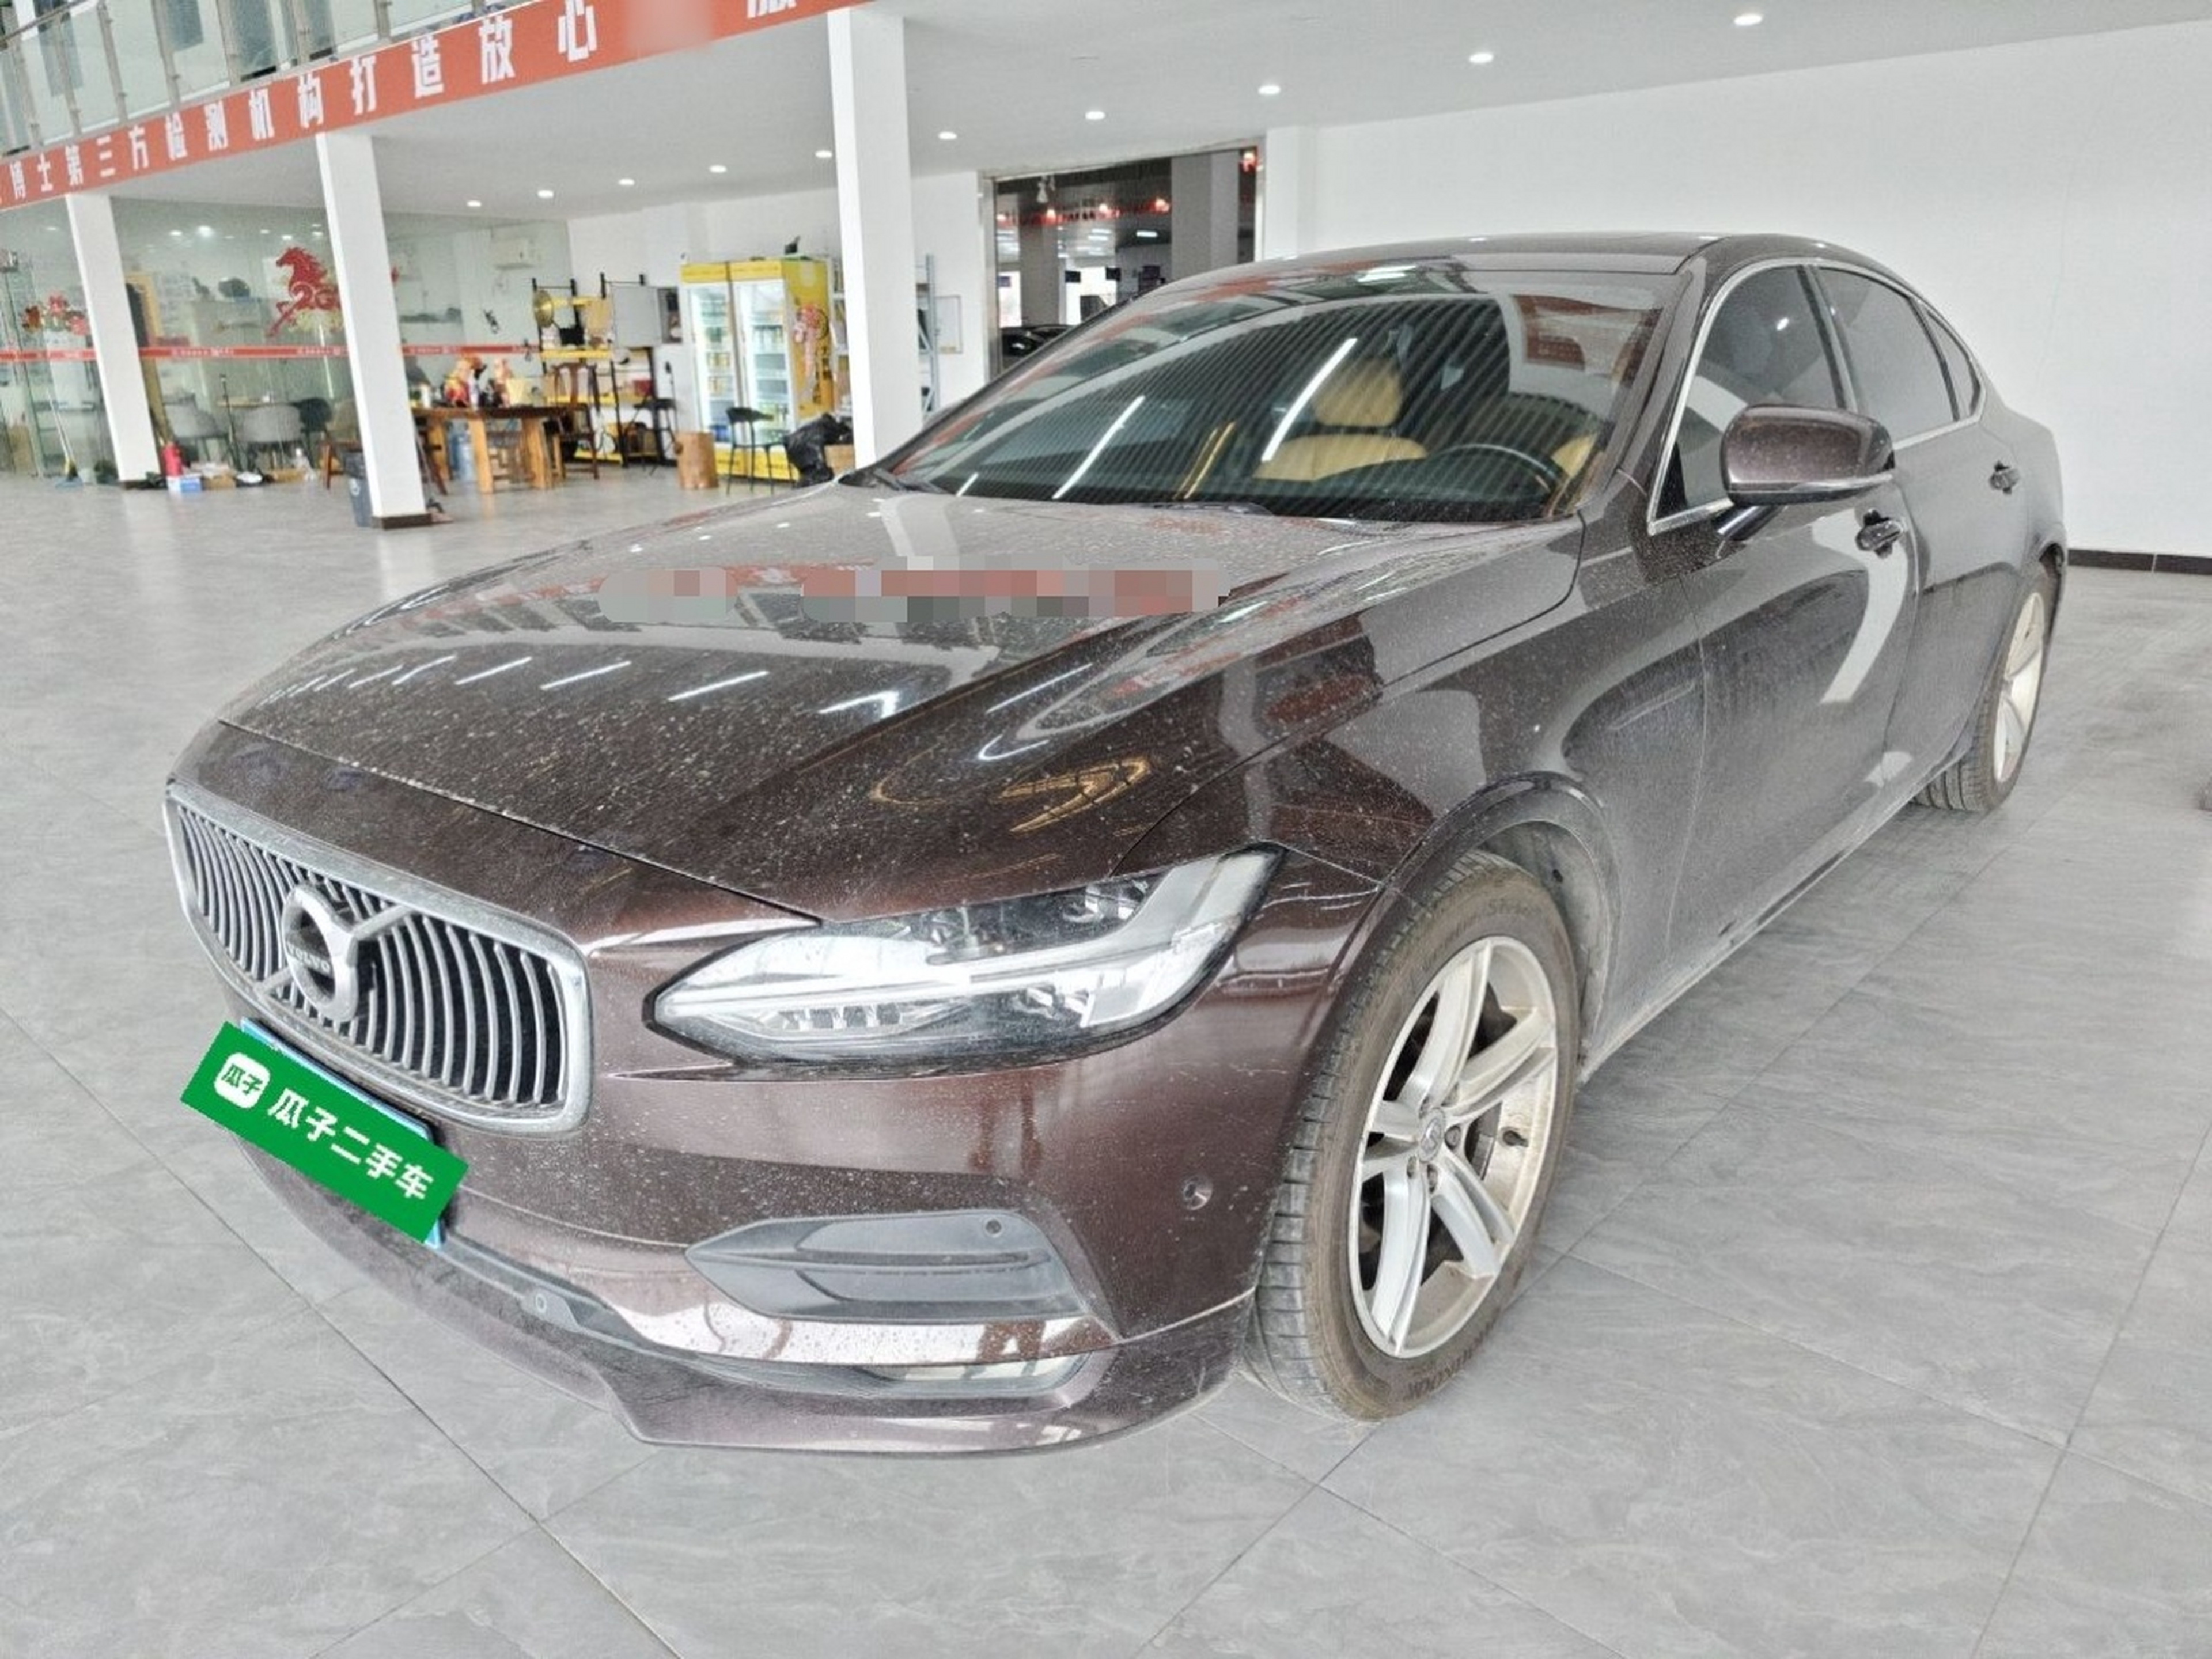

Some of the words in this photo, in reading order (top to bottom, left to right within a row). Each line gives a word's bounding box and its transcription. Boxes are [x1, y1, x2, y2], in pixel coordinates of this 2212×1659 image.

[9, 0, 796, 199] 博士第三方检测机构打造放心
